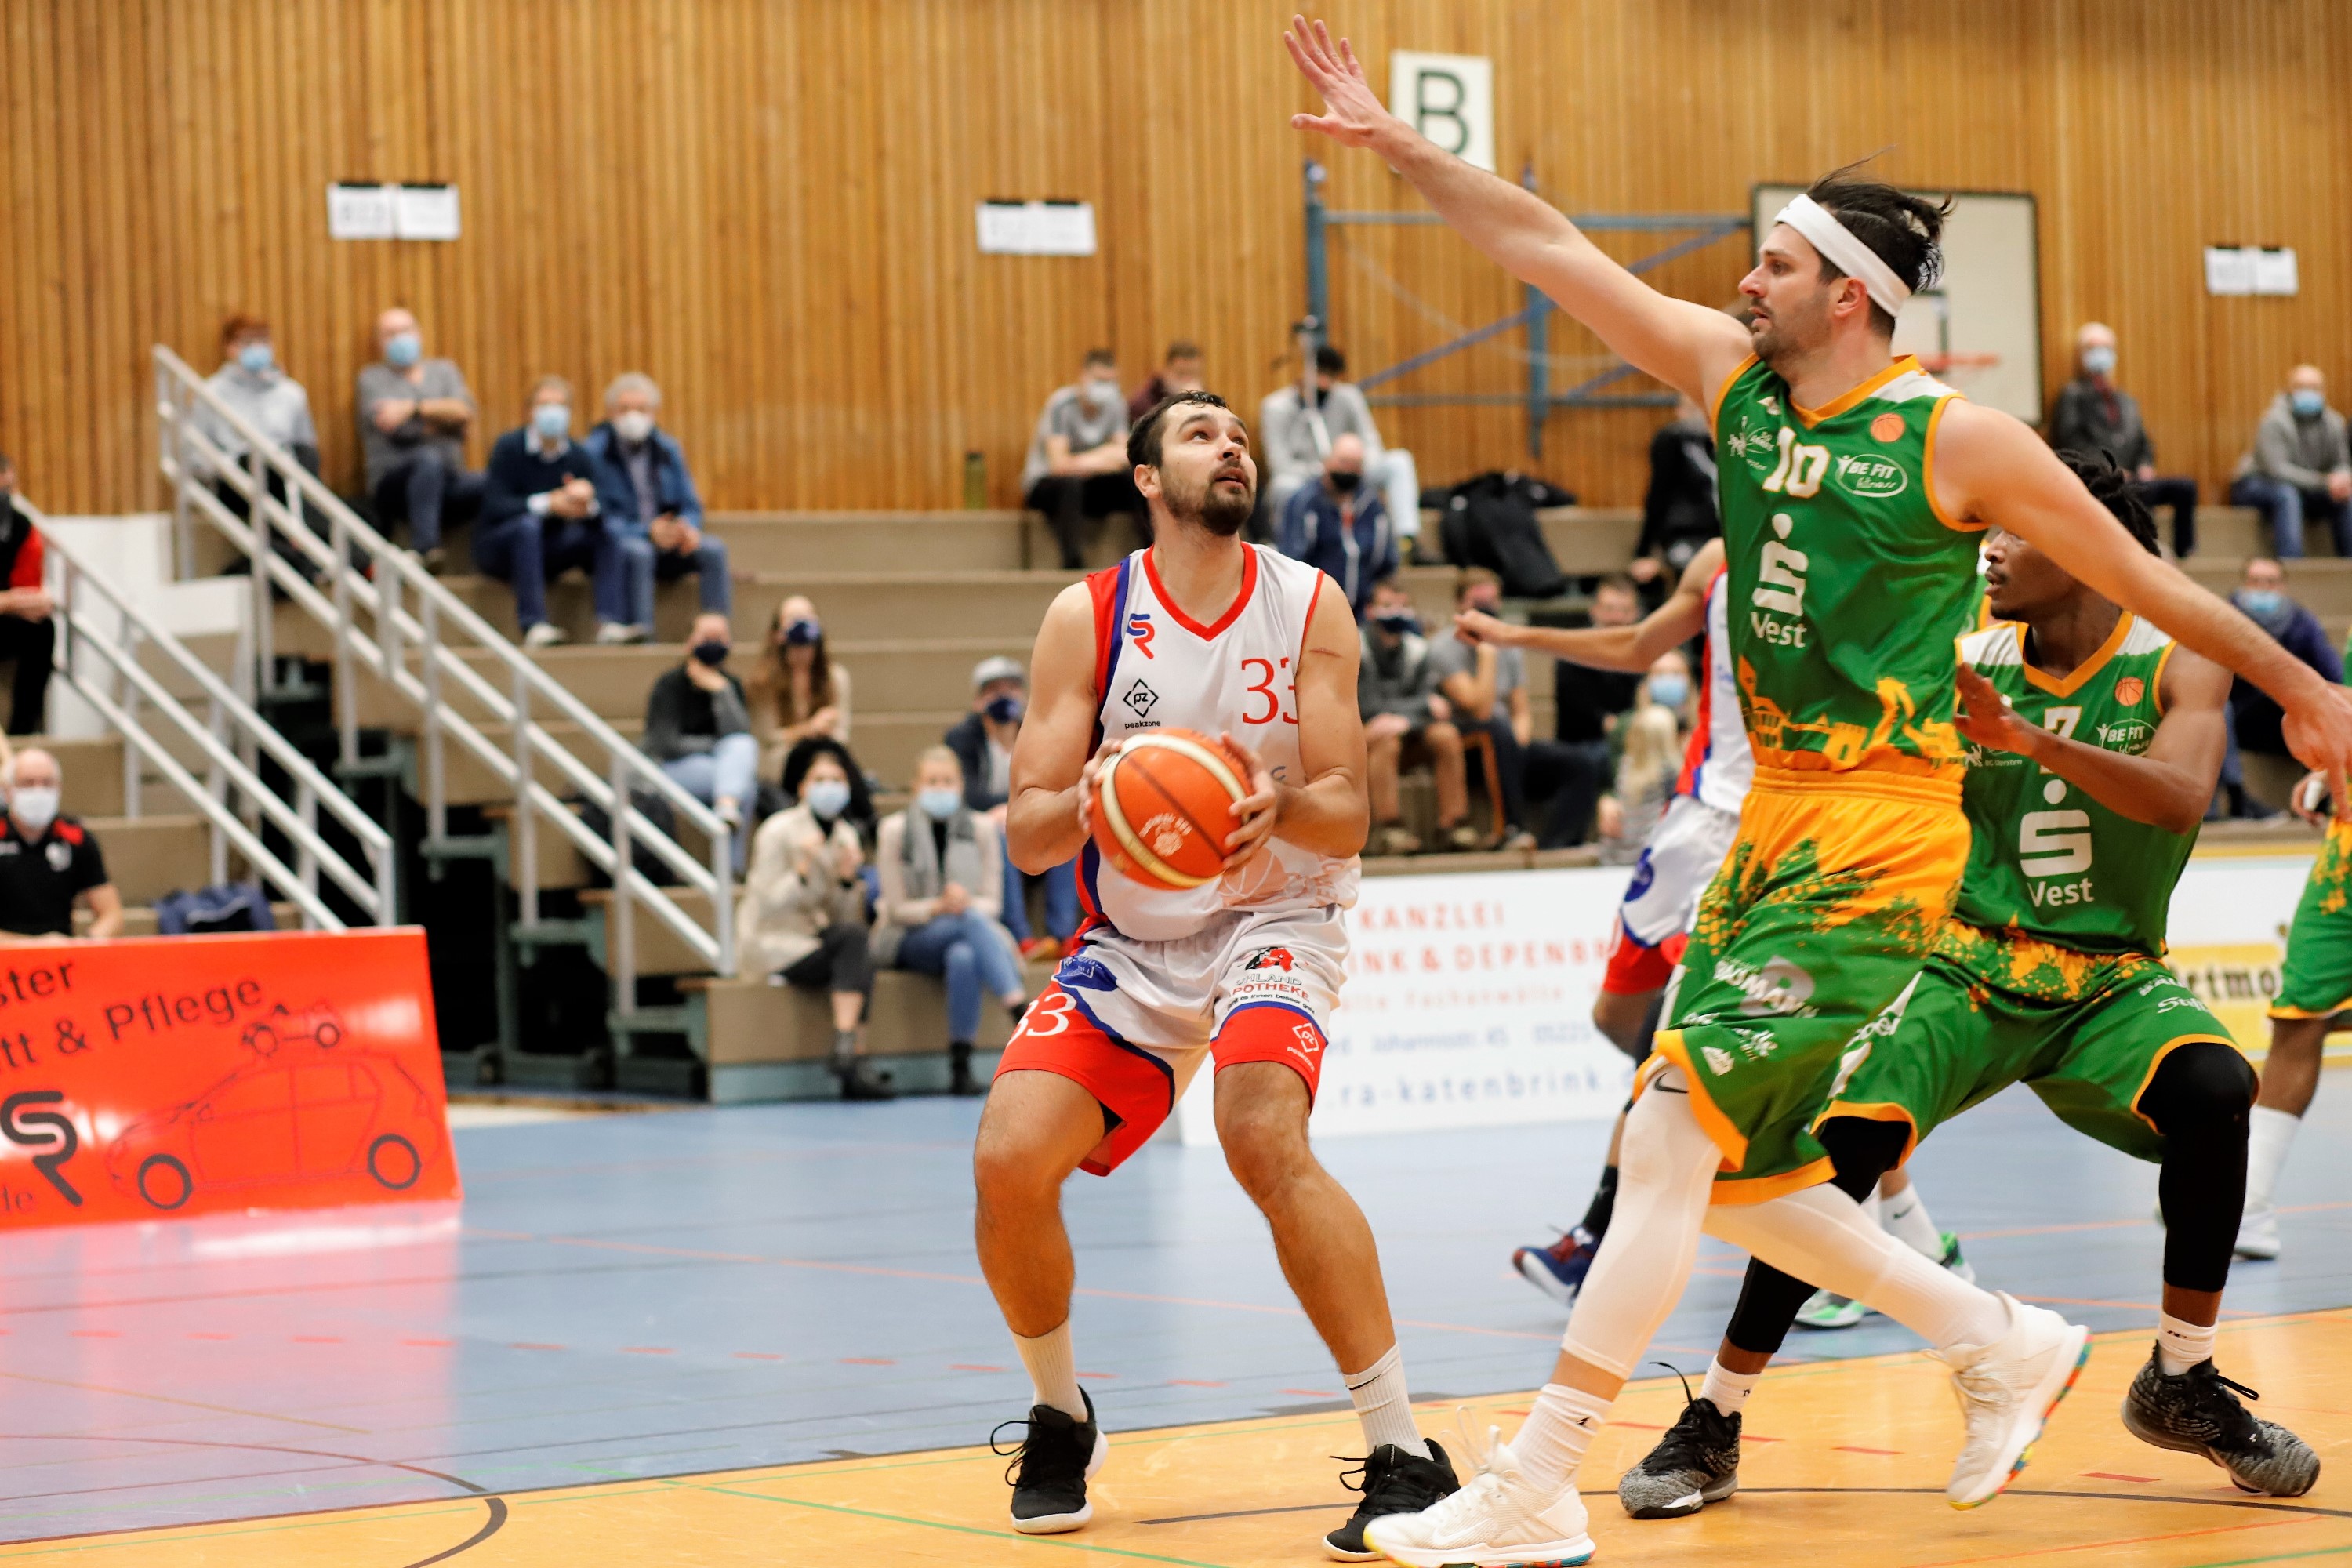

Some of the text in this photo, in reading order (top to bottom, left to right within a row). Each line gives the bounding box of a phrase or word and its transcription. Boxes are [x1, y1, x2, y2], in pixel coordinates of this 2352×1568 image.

[1417, 69, 1468, 154] B
[1762, 426, 1831, 499] 10
[1847, 461, 1897, 479] BE FIT
[1750, 611, 1808, 648] Vest
[1124, 720, 1161, 730] peakzone
[2107, 726, 2146, 742] BE FIT
[2027, 877, 2095, 908] Vest
[1359, 901, 1504, 931] KANZLEI
[1420, 944, 1443, 972] &
[56, 1019, 93, 1054] &
[103, 978, 263, 1041] Pflege
